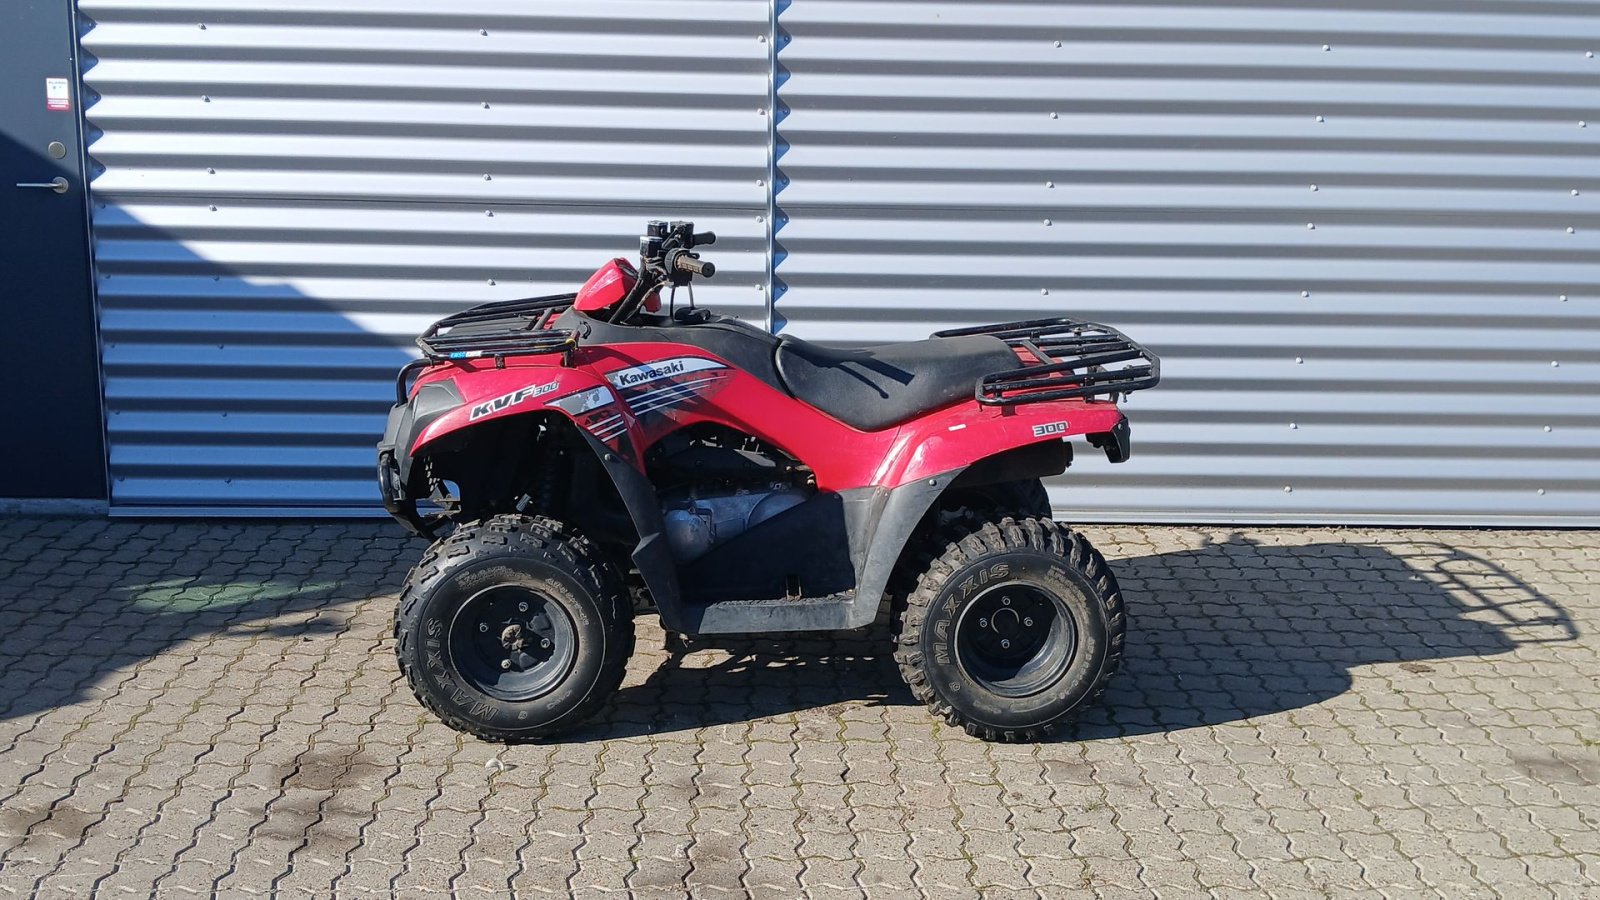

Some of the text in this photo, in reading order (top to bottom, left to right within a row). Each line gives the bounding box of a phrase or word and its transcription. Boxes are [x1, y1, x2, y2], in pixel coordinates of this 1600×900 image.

[619, 361, 684, 385] Kawasaki
[470, 381, 559, 421] KVF 300
[1032, 420, 1069, 437] 300
[932, 562, 1009, 665] MAXXIS
[425, 617, 499, 721] MAXXIS
